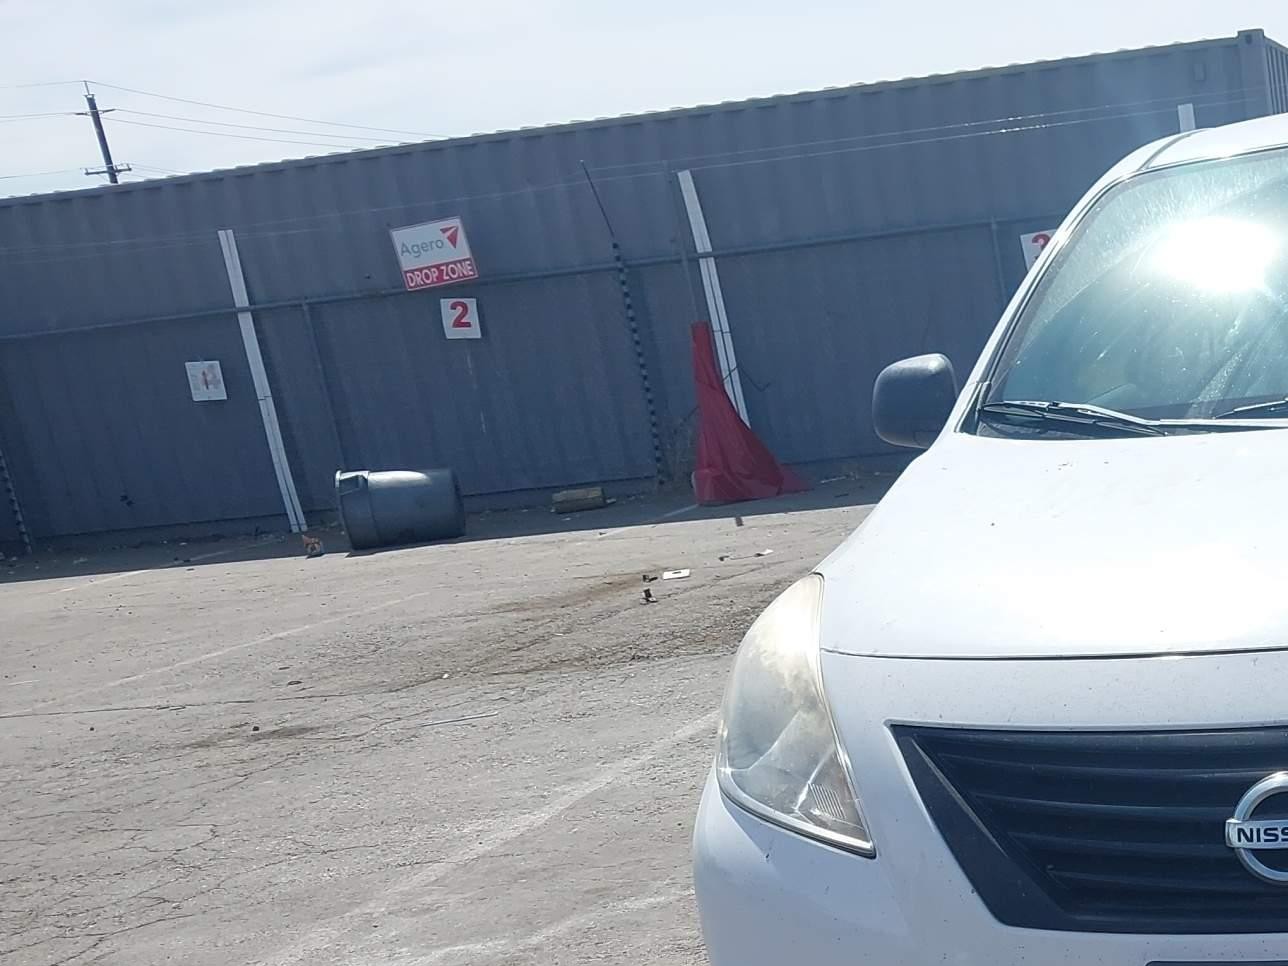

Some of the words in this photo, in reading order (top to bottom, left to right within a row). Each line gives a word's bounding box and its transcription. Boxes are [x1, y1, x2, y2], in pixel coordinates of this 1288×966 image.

[400, 239, 444, 258] Agero
[406, 268, 439, 287] DROP
[441, 260, 474, 281] ZONE
[449, 300, 472, 329] 2
